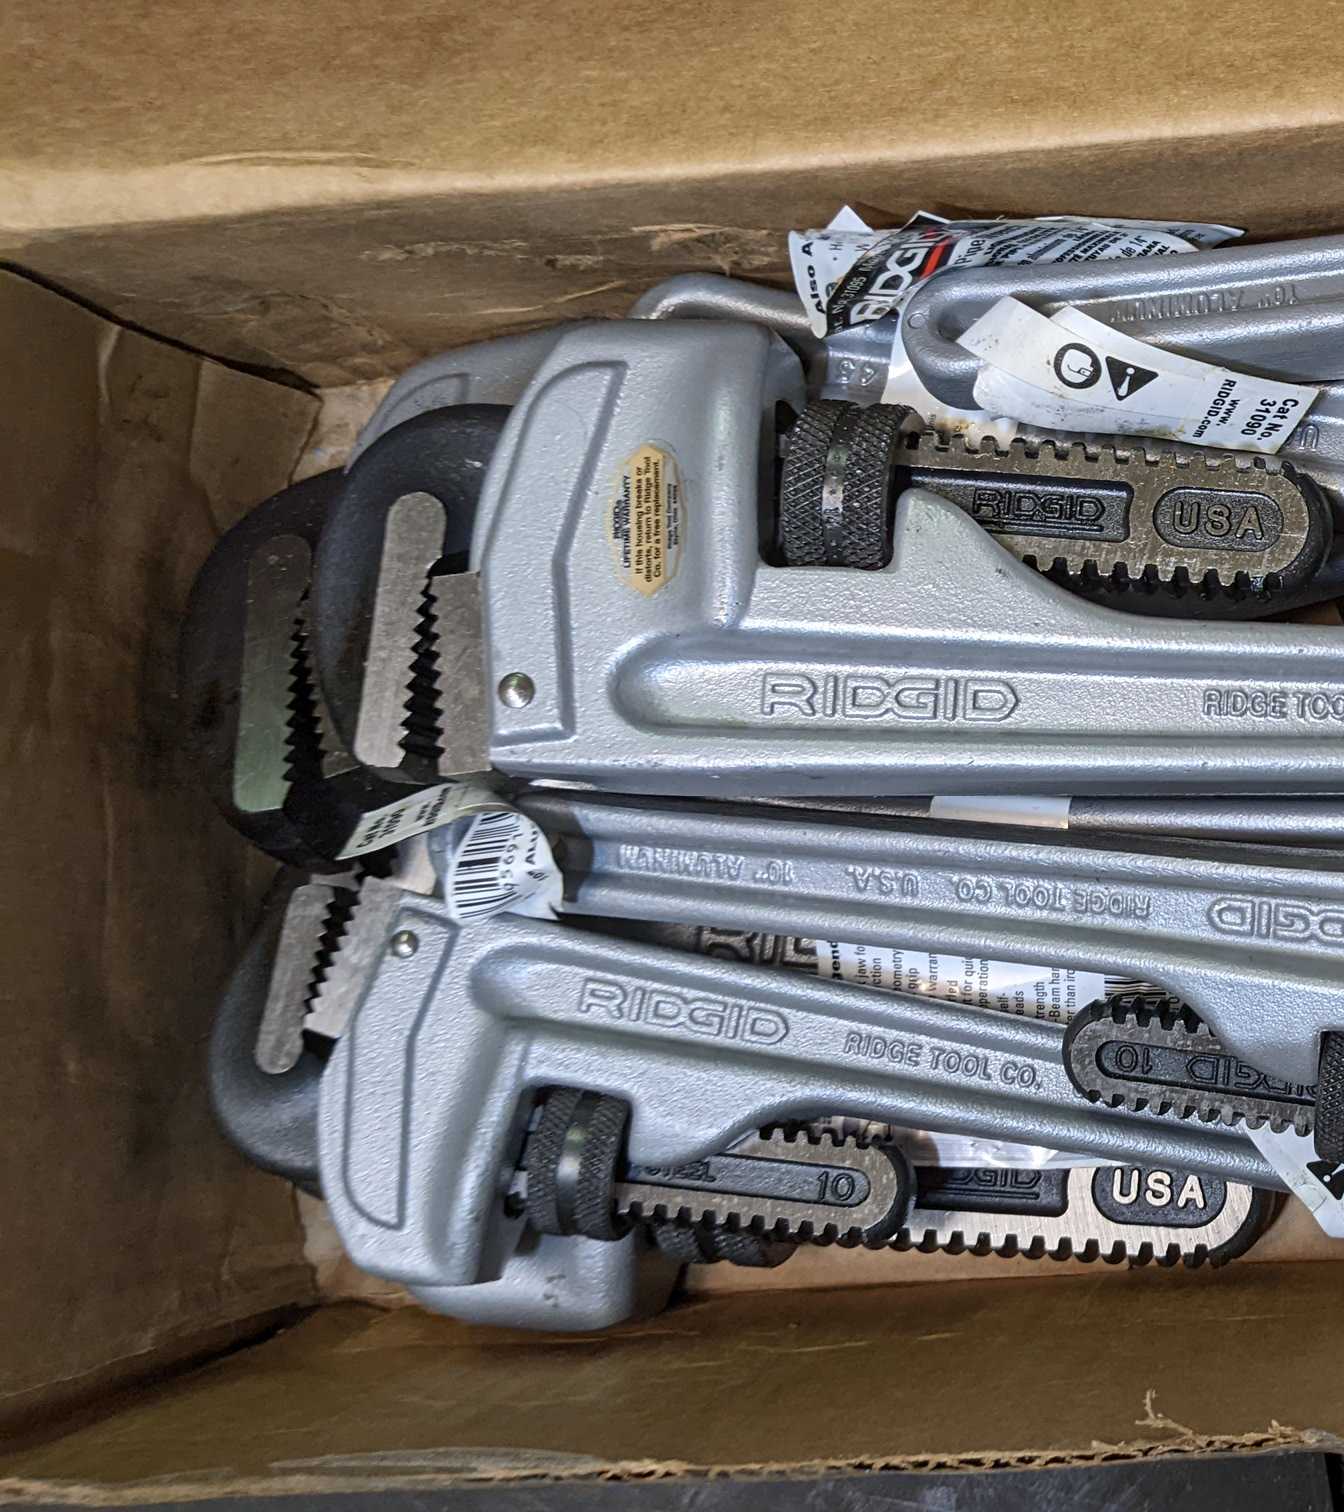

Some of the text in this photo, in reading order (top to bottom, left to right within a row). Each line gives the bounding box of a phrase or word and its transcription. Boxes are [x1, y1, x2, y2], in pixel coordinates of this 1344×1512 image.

[1193, 378, 1237, 438] RIDGID.com
[1215, 399, 1240, 427] www.
[1241, 399, 1277, 436] 31090
[1257, 398, 1299, 441] Cat No.
[972, 488, 1106, 523] RIDGID
[1173, 499, 1266, 541] USA
[760, 673, 1019, 721] RIDGID
[1201, 688, 1288, 719] RIDGE
[998, 878, 1065, 909] TOOL
[1076, 890, 1151, 919] RIDGE
[577, 978, 790, 1045] RIDGID
[843, 1032, 923, 1067] RIDGE
[930, 1047, 992, 1081] TOOL
[1114, 1044, 1153, 1075] 10
[817, 1171, 856, 1202] 10
[1112, 1168, 1205, 1209] USA
